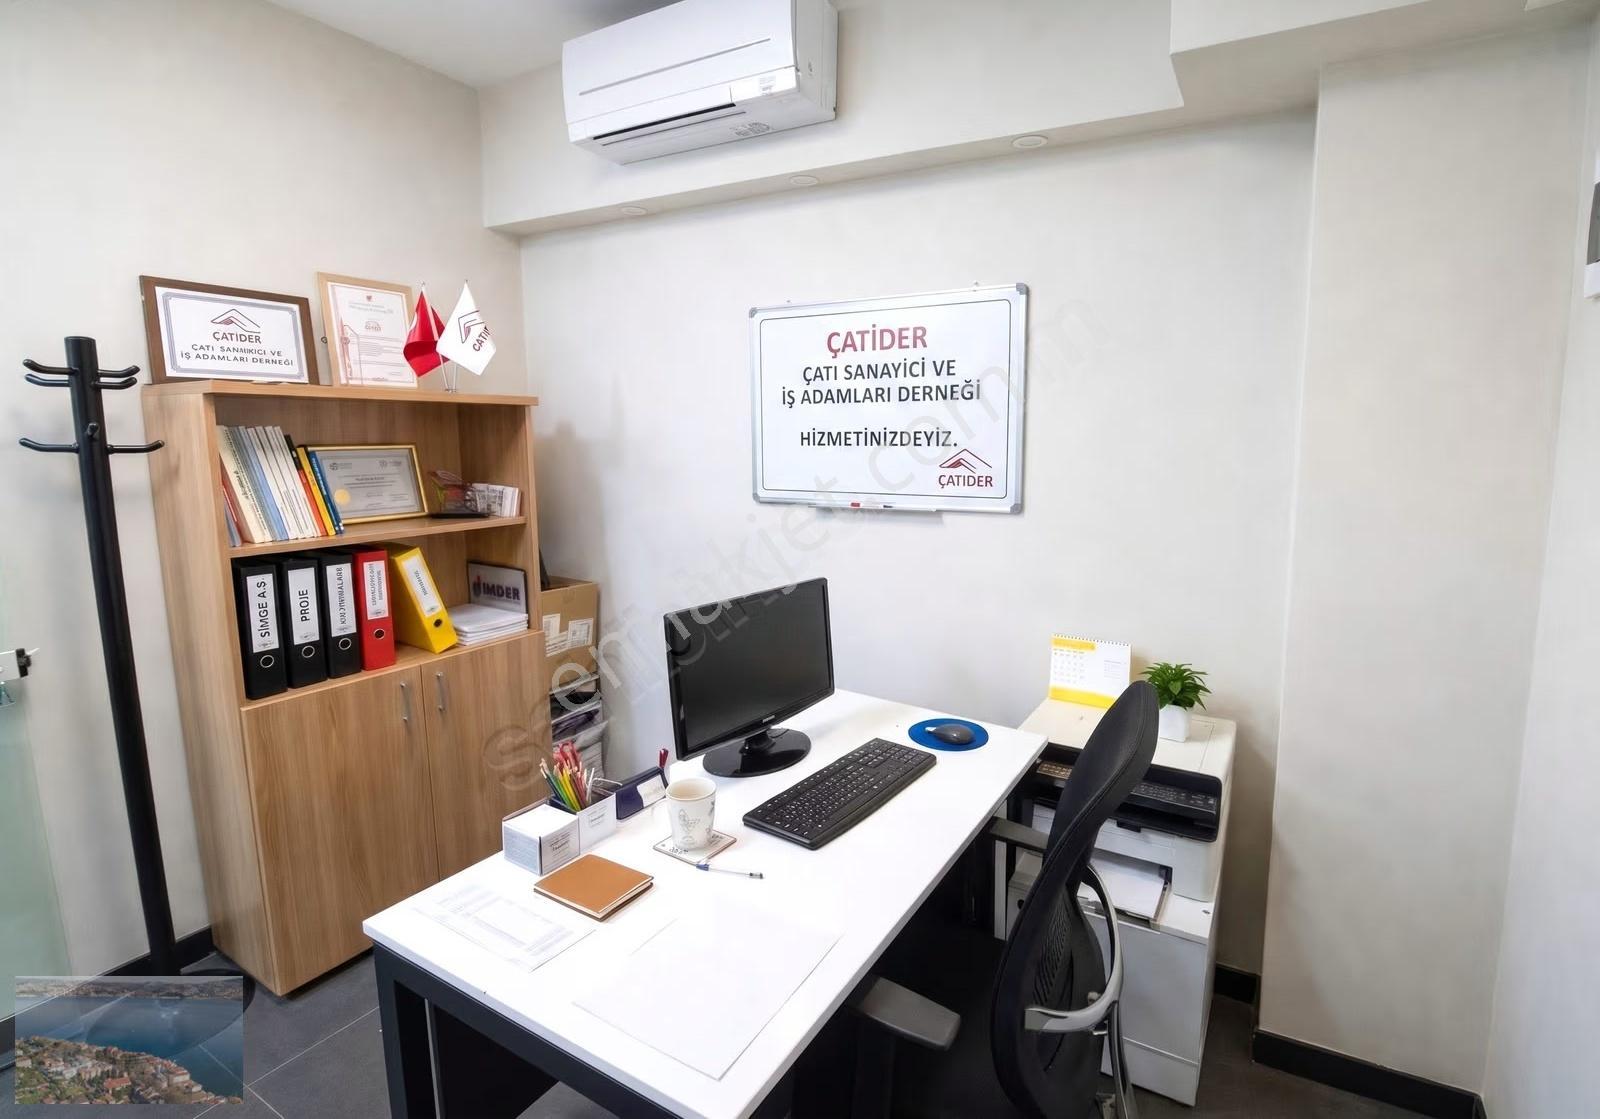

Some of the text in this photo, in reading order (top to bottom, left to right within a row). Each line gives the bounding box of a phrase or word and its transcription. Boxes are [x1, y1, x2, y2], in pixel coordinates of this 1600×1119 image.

[826, 324, 928, 359] ÇATİDER
[195, 353, 248, 362] ADAMLARI
[802, 357, 956, 385] ÇATI SANAYİCİ VE
[782, 379, 981, 408] İŞ ADAMLARI DERNEĞİ
[800, 427, 958, 447] HİZMETİNİZDEYİZ.
